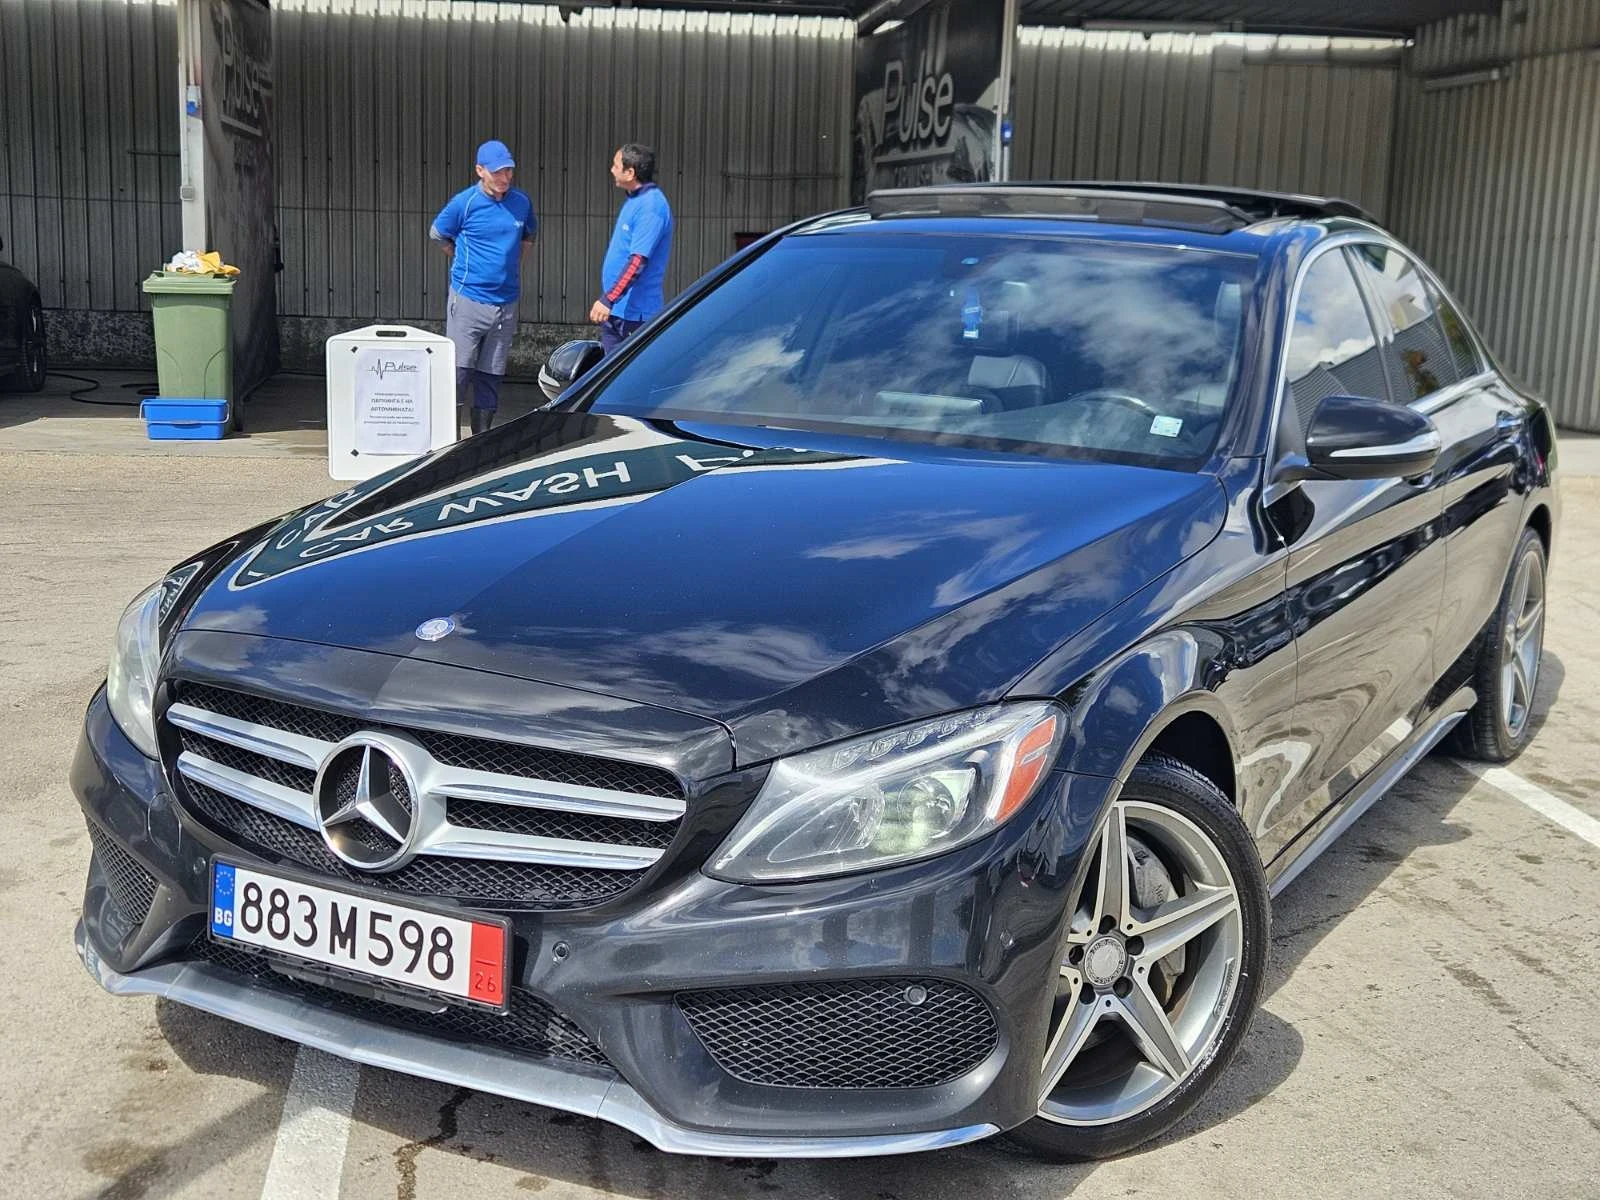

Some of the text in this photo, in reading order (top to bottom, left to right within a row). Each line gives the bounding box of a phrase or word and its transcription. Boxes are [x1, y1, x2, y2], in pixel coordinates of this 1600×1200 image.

[879, 50, 953, 146] Pulse
[214, 906, 233, 928] BG
[475, 971, 497, 993] 26
